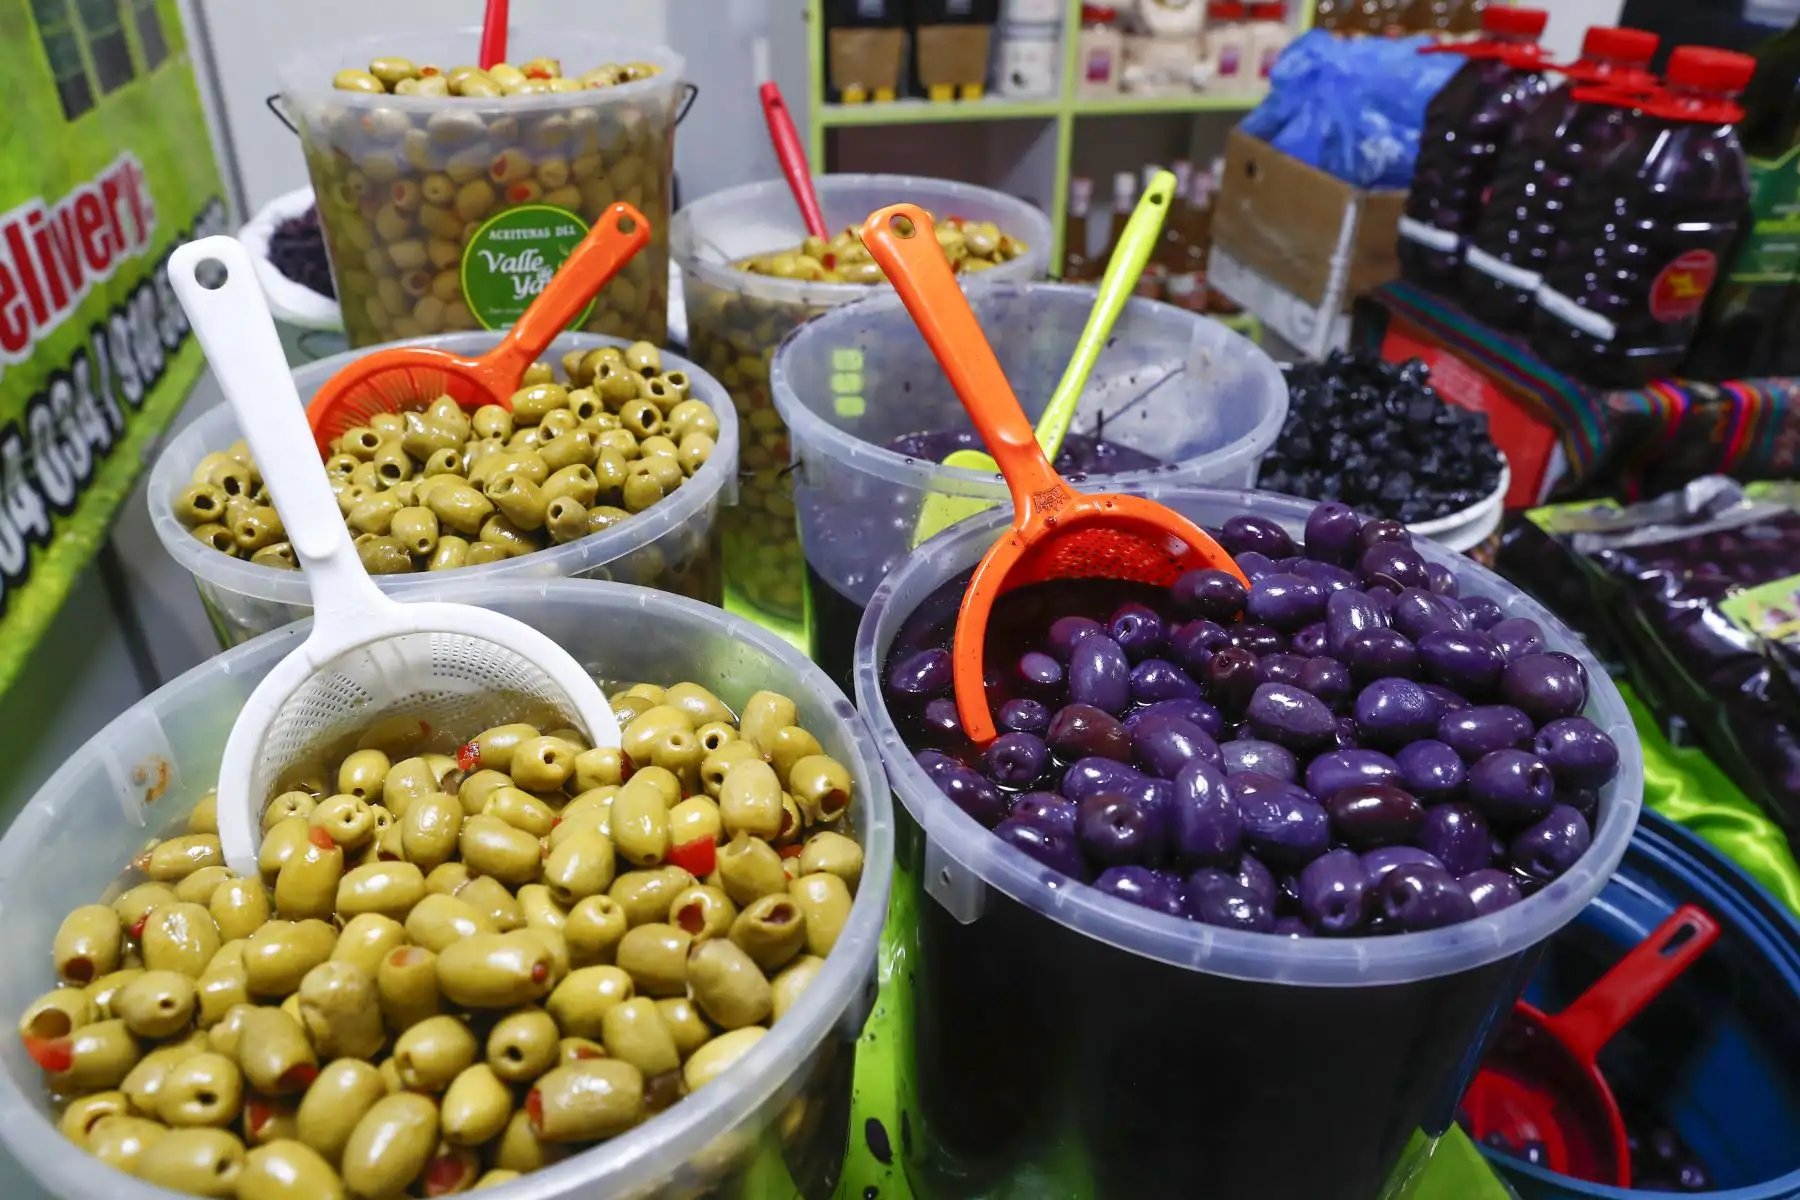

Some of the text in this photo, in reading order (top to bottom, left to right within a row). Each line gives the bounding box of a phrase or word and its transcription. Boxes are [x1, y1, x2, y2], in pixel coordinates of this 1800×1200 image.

[488, 227, 551, 241] ACEITUNAS
[477, 248, 544, 274] Valle
[510, 275, 547, 300] Ya
